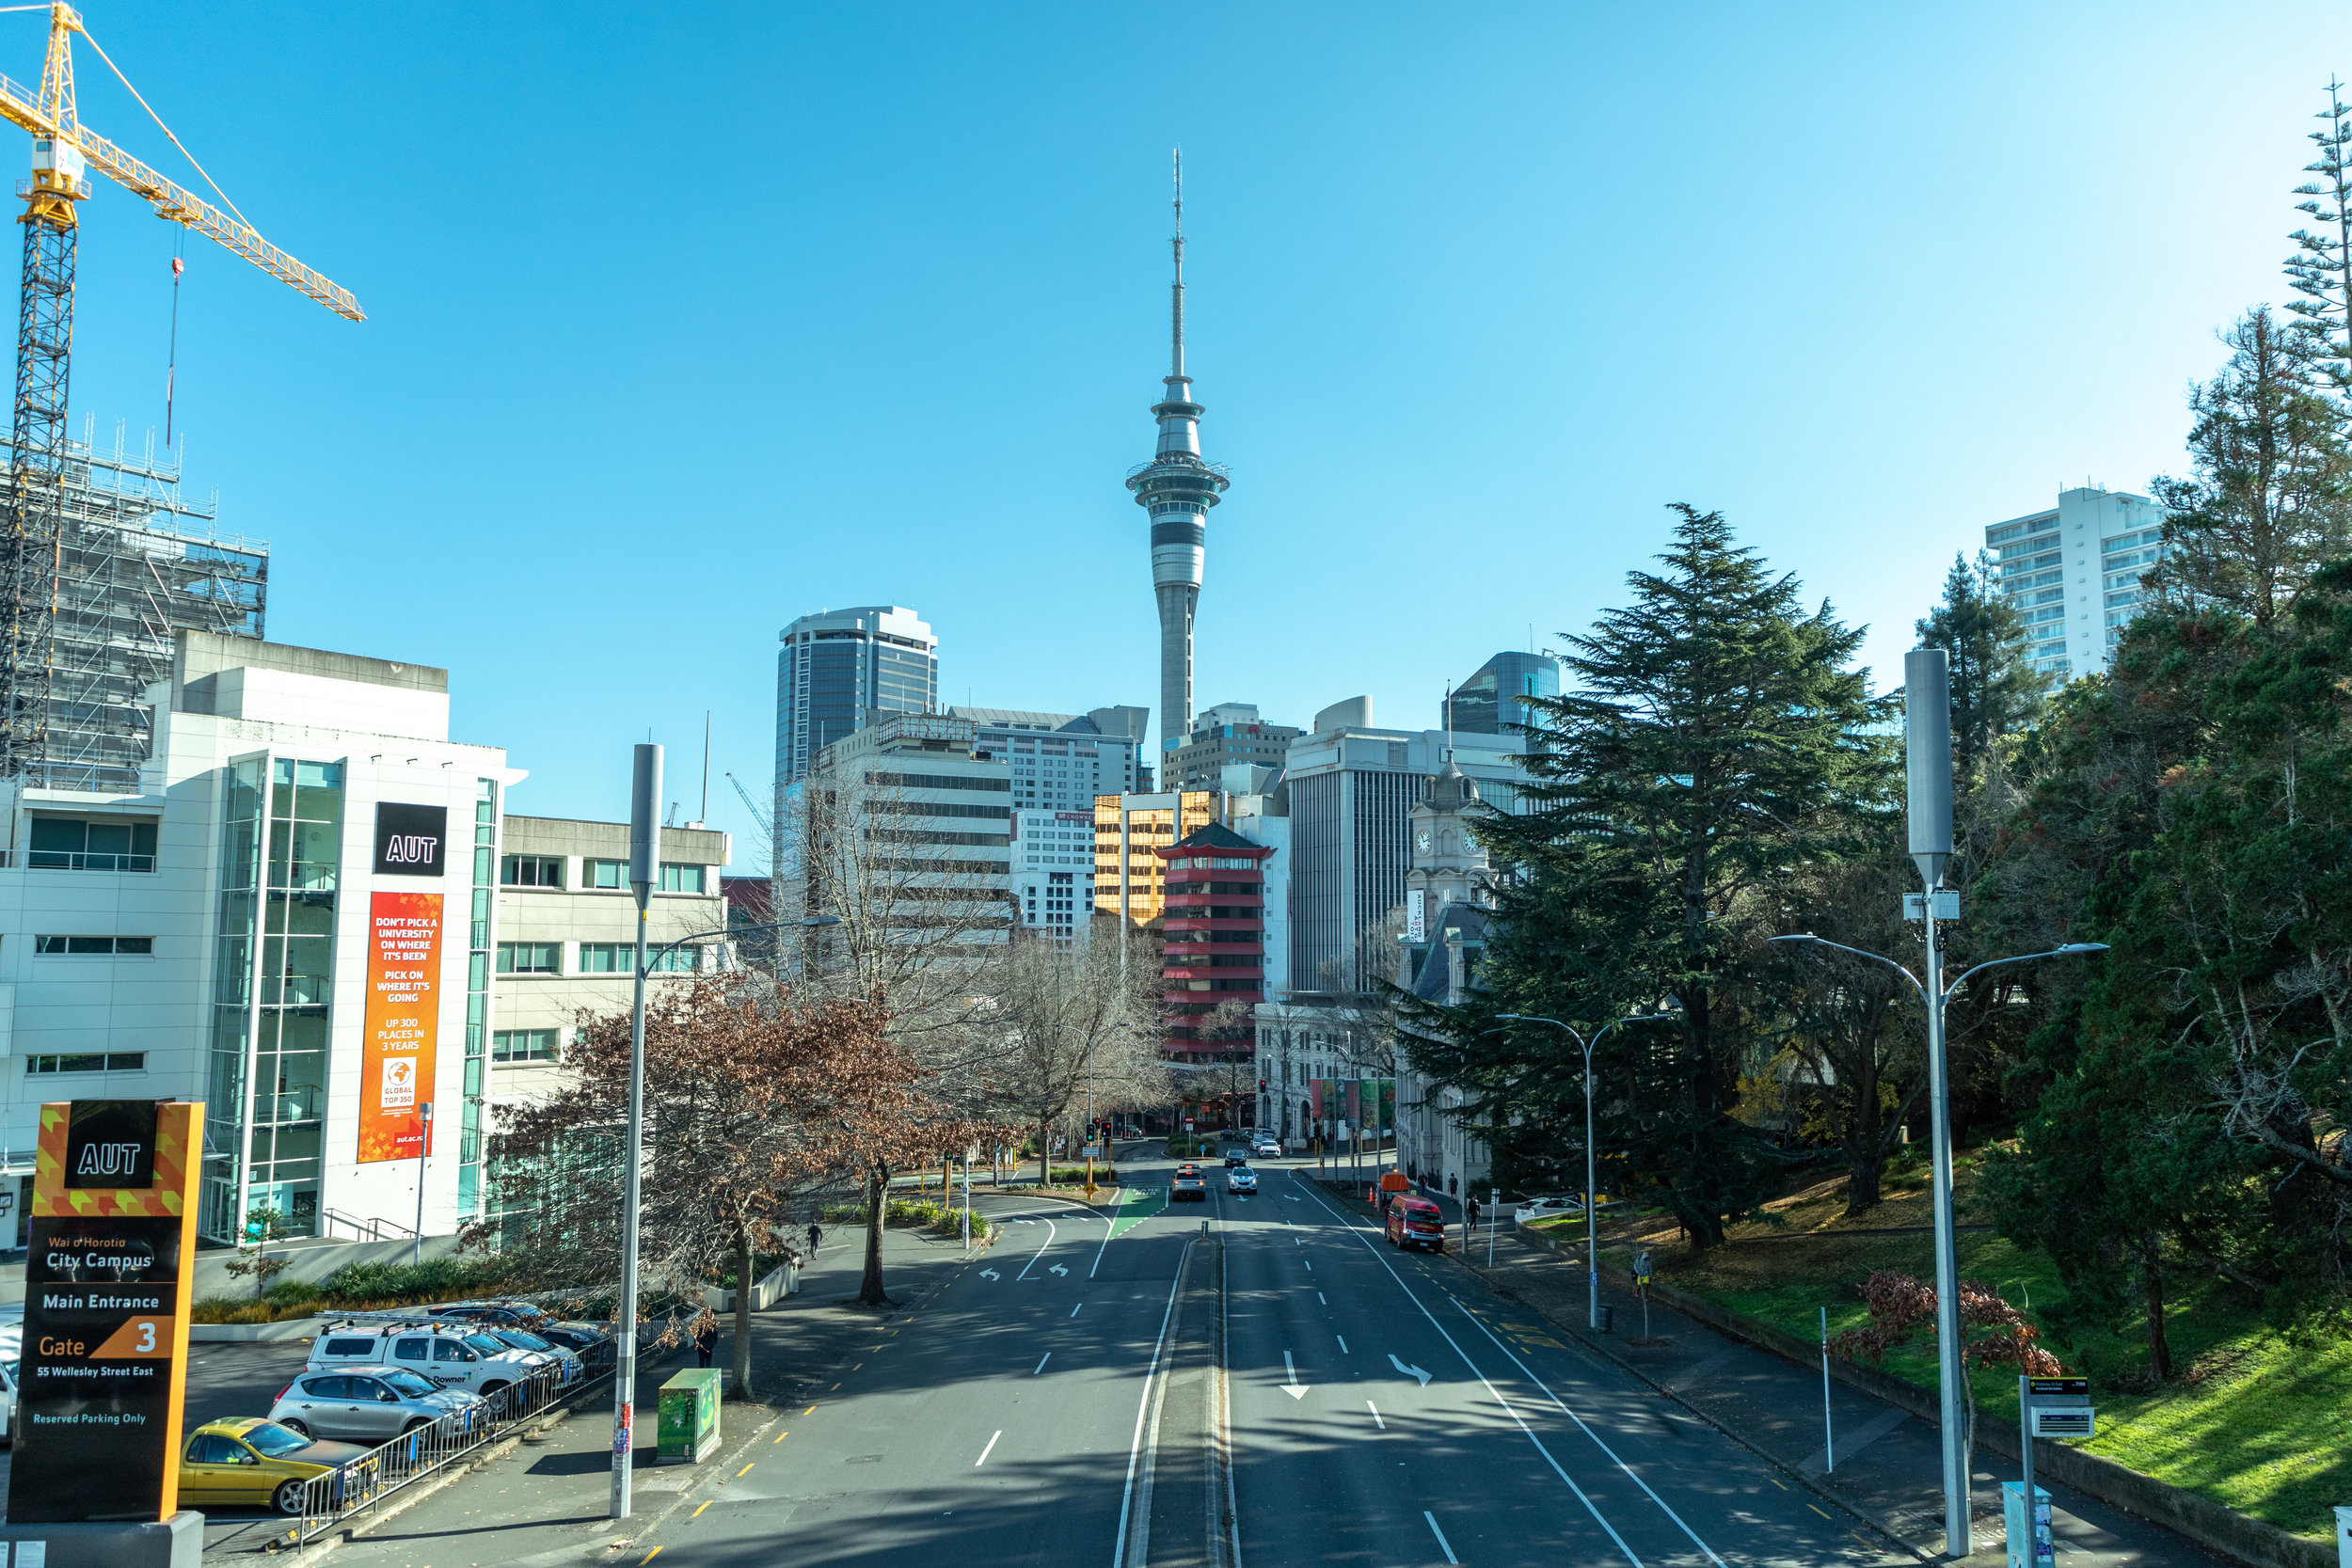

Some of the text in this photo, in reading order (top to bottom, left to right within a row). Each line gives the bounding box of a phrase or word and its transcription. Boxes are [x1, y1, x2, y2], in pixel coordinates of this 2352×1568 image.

[386, 835, 437, 863] AUT
[375, 917, 437, 927] DON'T PICK A
[378, 929, 434, 939] UNIVERSITY
[380, 941, 431, 950] ON WHERE
[383, 952, 427, 961] IT'S BEEN
[385, 971, 423, 980] PICK ON
[376, 982, 430, 991] WHERE IT'S
[388, 993, 419, 1003] GOING
[386, 1018, 418, 1028] UP 300
[377, 1029, 424, 1039] PLACES IN
[381, 1041, 420, 1052] 3 YEARS
[384, 1086, 412, 1095] GLOBAL
[77, 1143, 140, 1175] AUT
[48, 1237, 71, 1247] Wai
[47, 1252, 151, 1272] City Campus
[43, 1293, 159, 1308] Main Entrance
[40, 1322, 156, 1355] Gate 3
[37, 1367, 153, 1379] 55 Wellesley Street East
[433, 1375, 467, 1384] Downer
[33, 1413, 147, 1425] Reserved Parking Only
